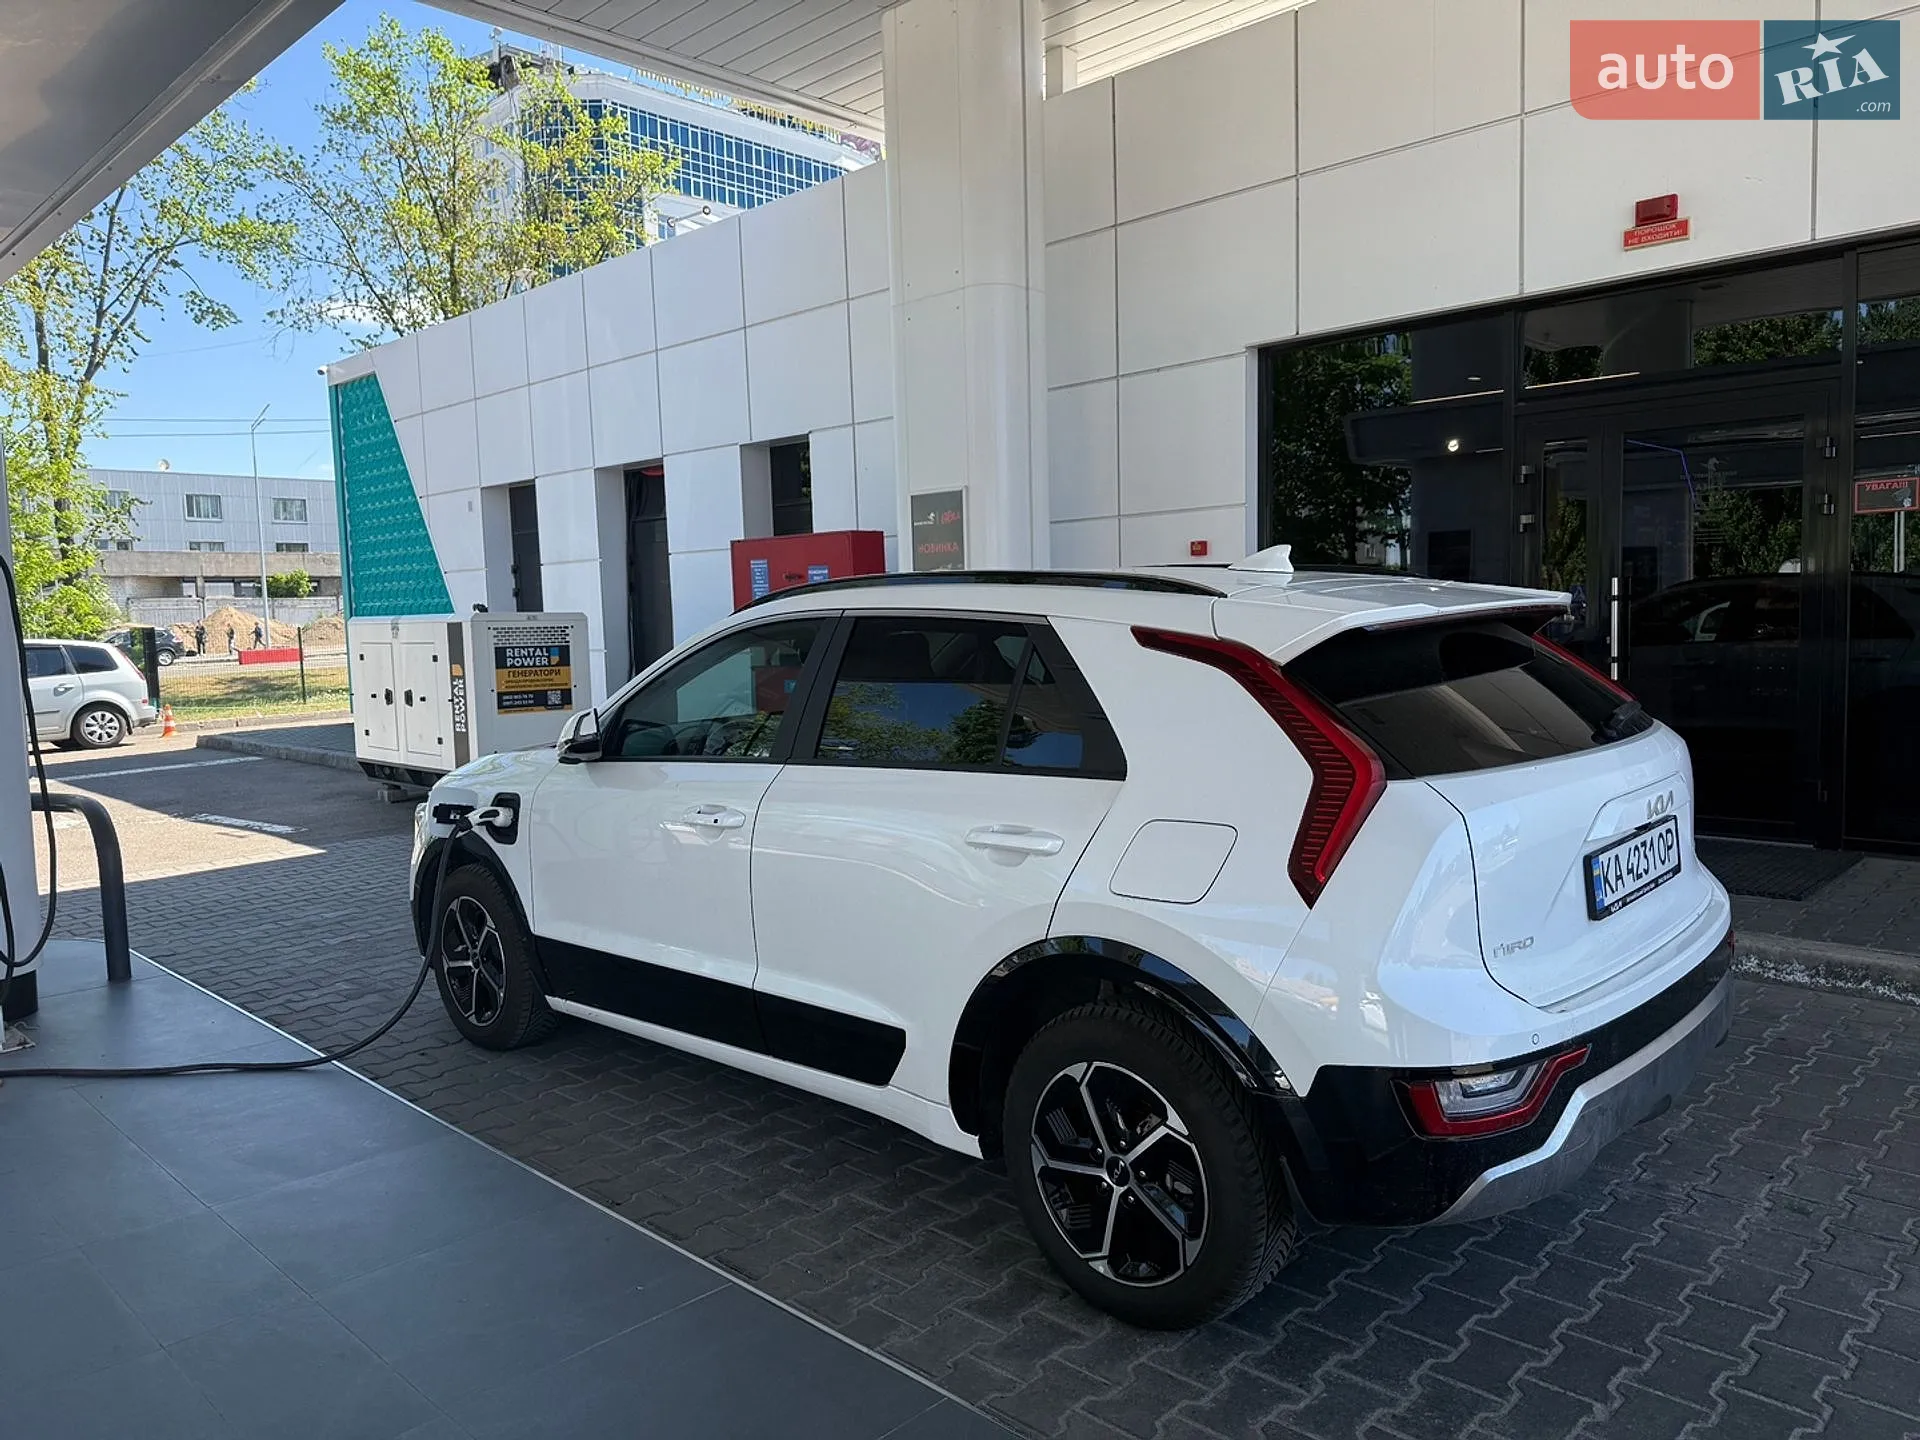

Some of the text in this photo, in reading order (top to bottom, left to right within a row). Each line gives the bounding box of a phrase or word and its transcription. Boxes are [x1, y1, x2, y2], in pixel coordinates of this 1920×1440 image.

[505, 647, 549, 658] RENTAL
[506, 656, 549, 667] POWER
[507, 668, 561, 679] ГЕНЕРАТОРИ
[452, 678, 461, 732] RENTAL
[459, 678, 467, 733] POWER
[1626, 836, 1657, 883] 4231
